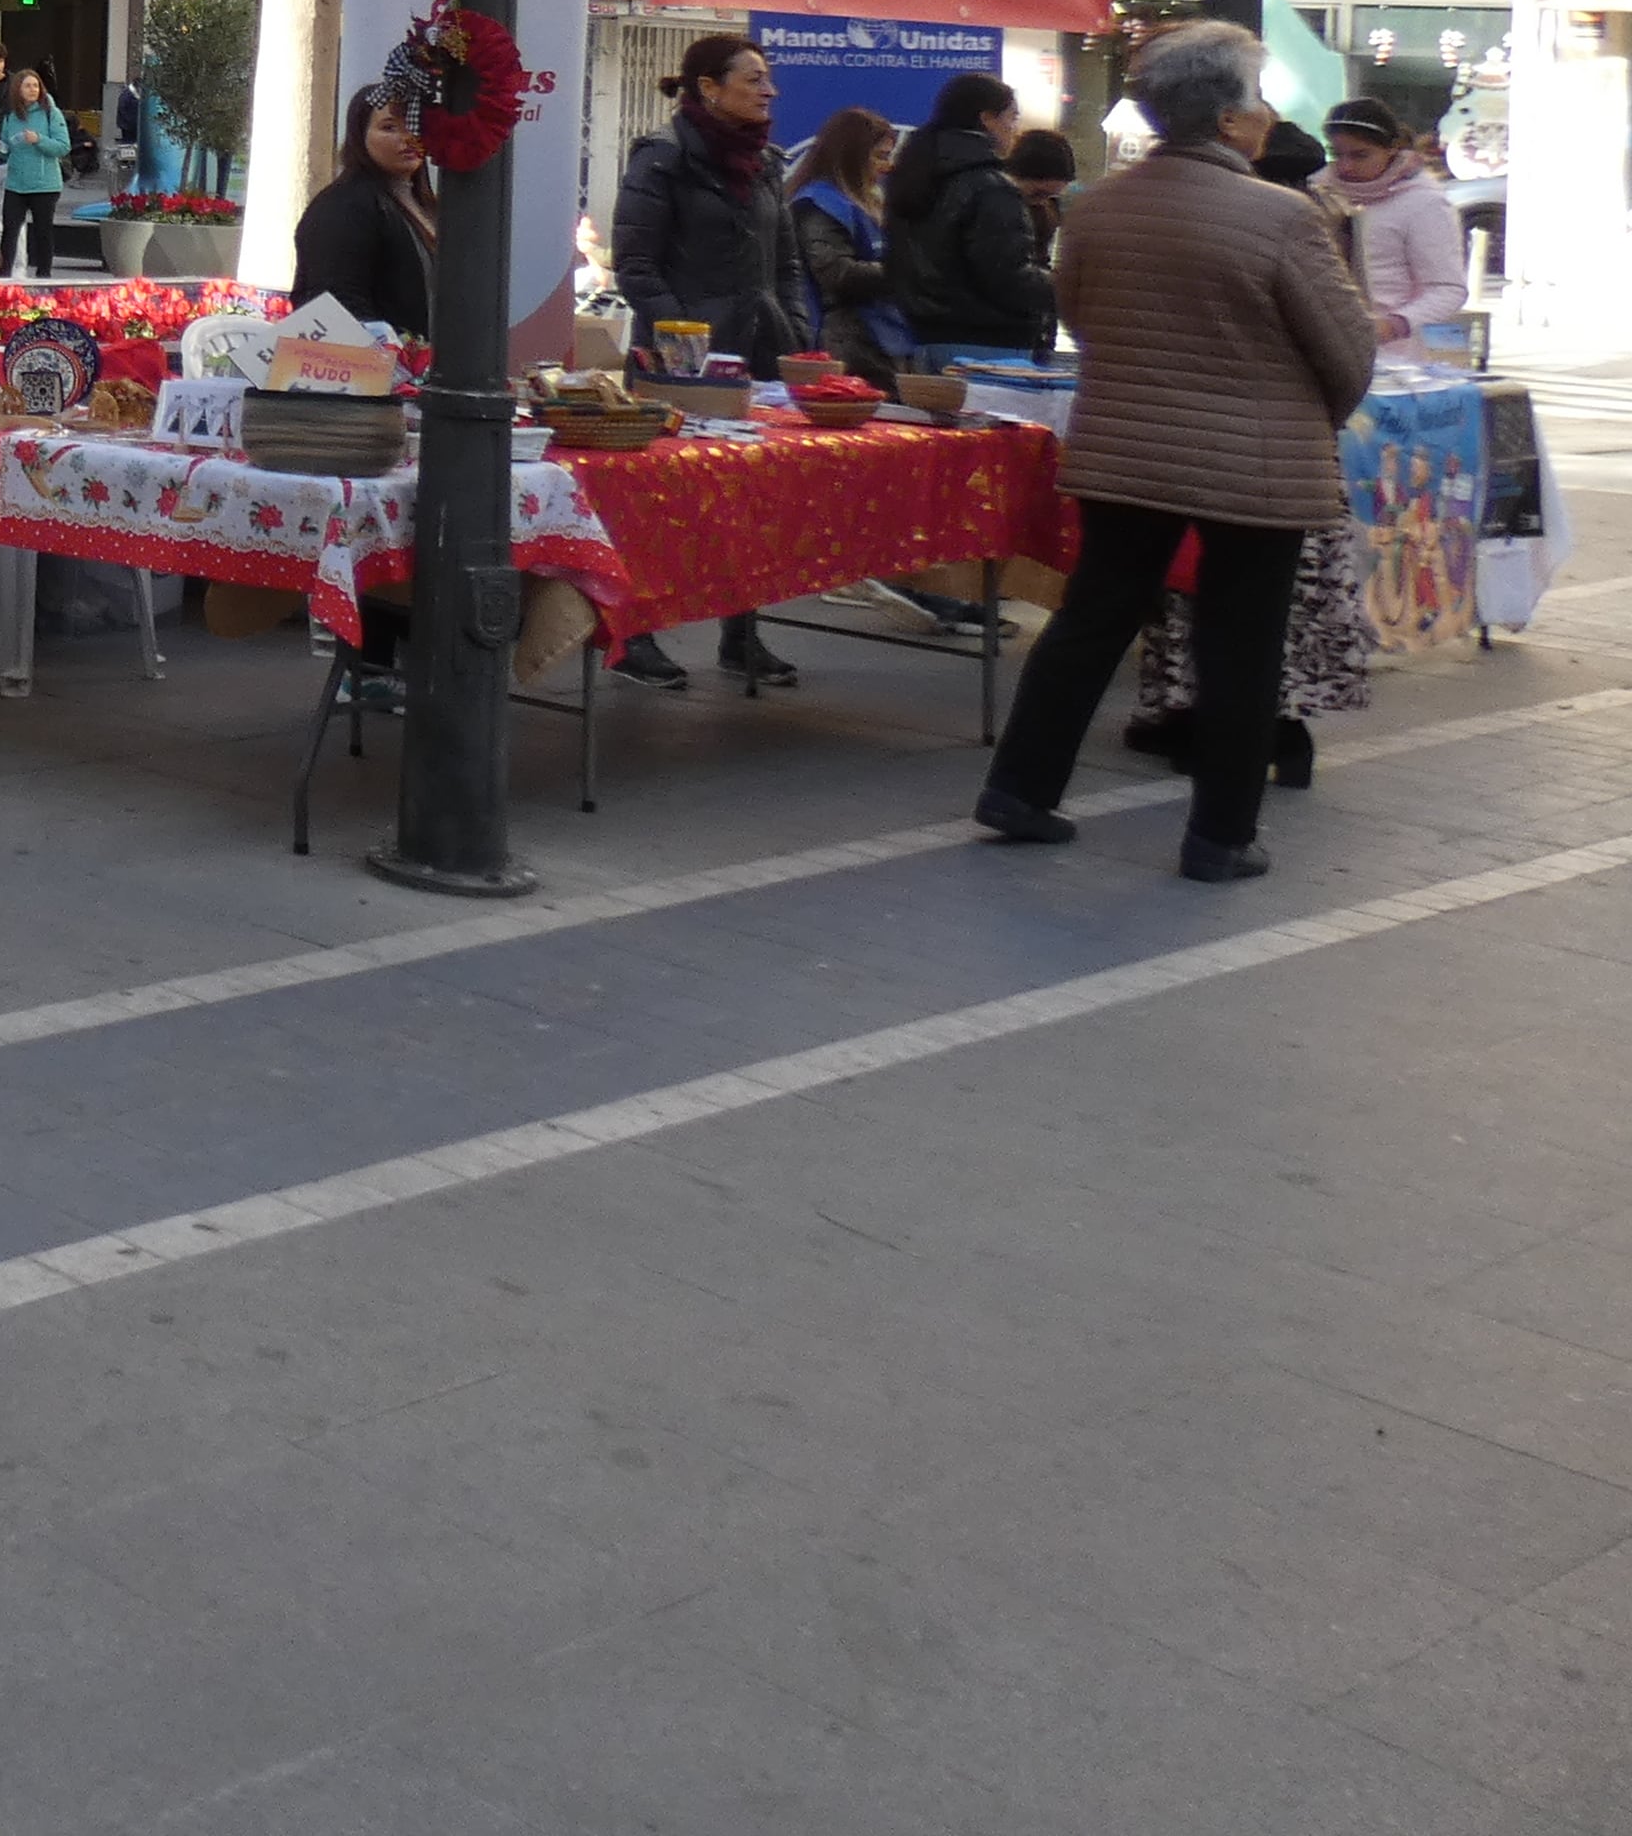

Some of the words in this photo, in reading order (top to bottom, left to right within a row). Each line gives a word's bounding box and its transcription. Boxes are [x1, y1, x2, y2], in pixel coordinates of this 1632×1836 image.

[760, 27, 847, 48] Manos
[899, 30, 994, 52] Unidas
[842, 53, 906, 69] CONTRA
[910, 55, 929, 70] EL
[929, 55, 992, 71] HAMBRE
